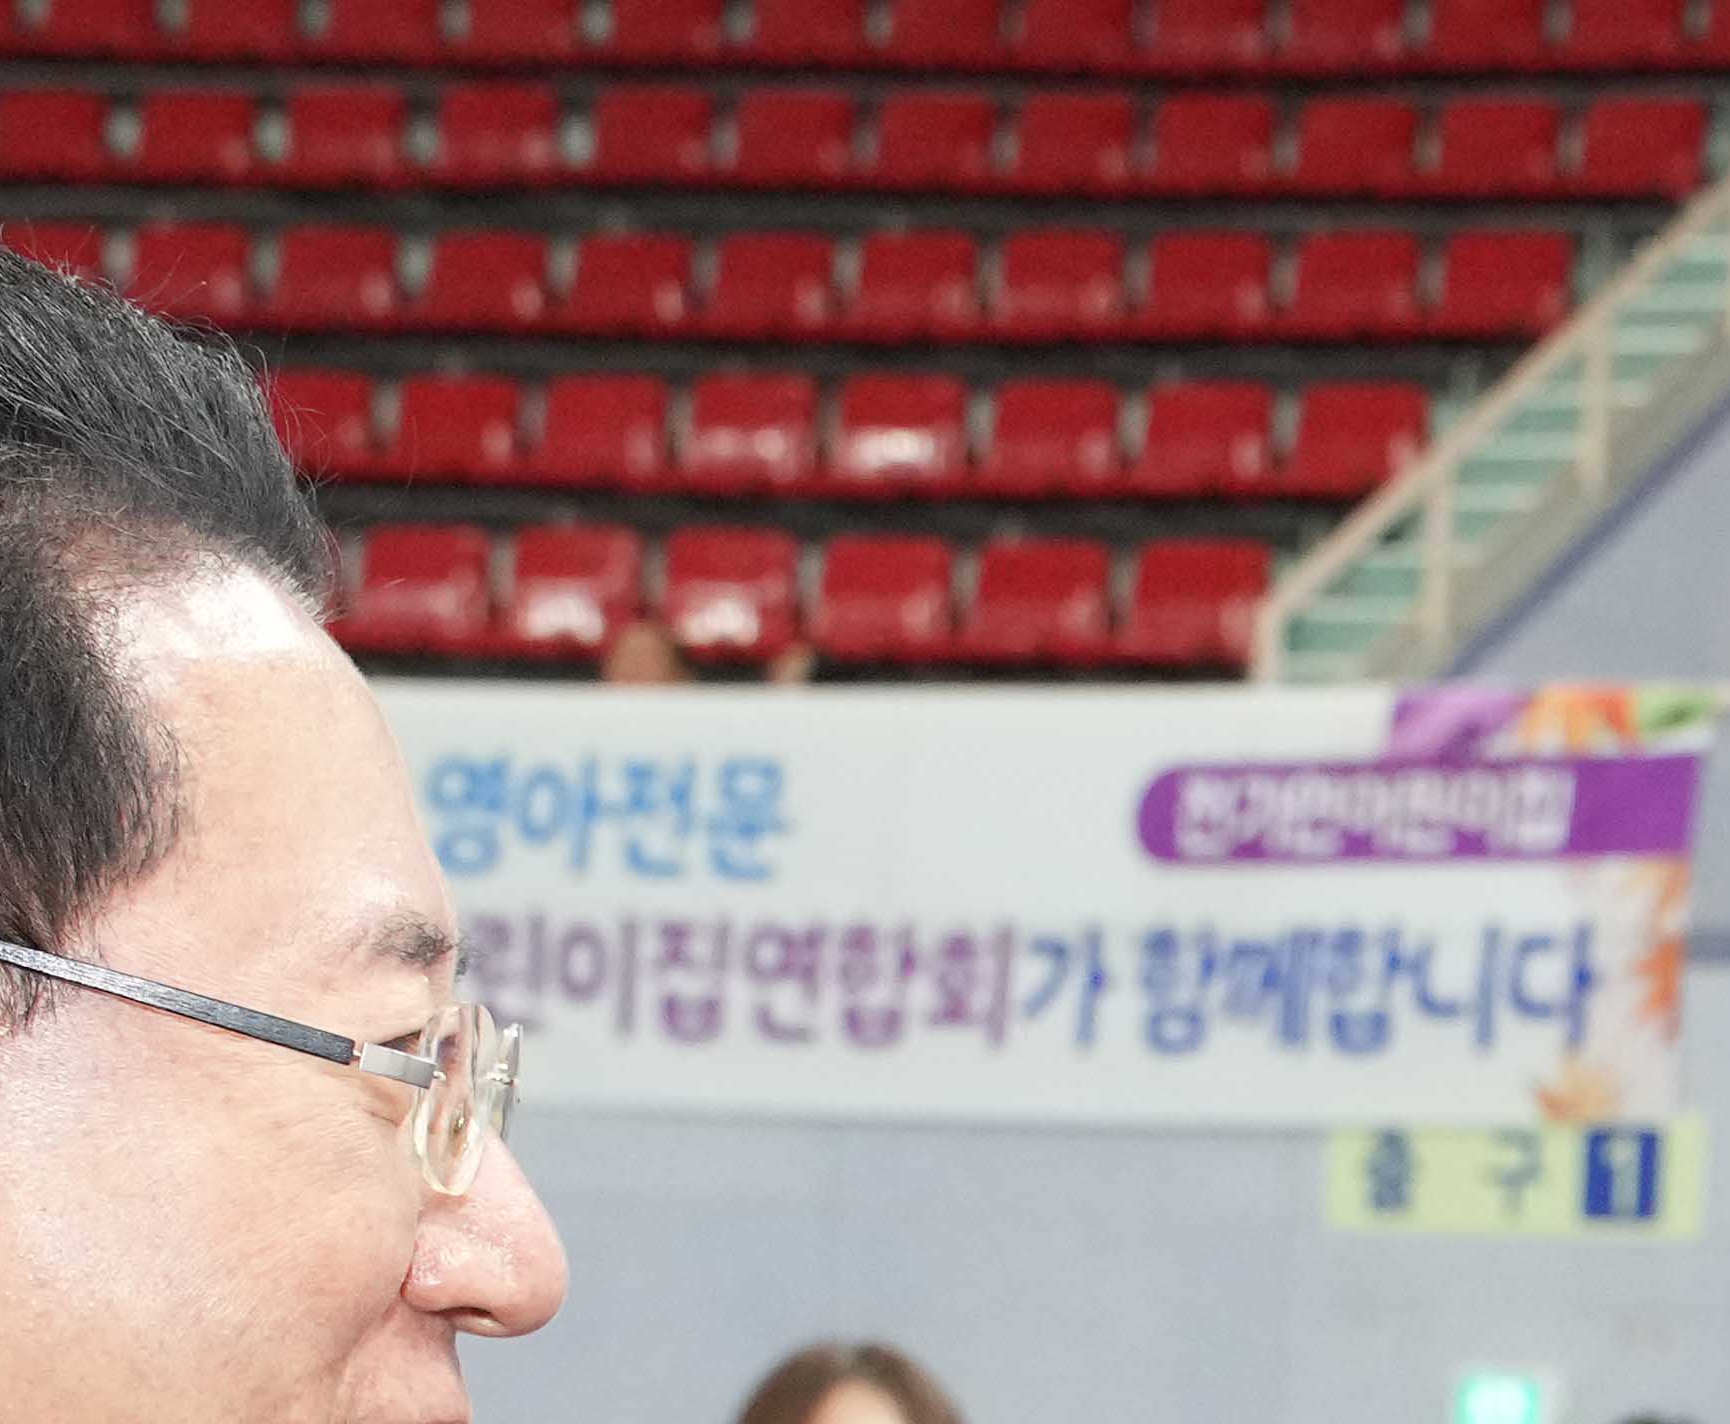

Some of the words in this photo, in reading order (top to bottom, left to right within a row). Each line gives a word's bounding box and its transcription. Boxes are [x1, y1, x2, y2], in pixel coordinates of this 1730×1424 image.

[425, 752, 792, 880] 영아전문
[464, 912, 1110, 1052] 린이집연합회가
[1138, 918, 1605, 1056] 함께합니다
